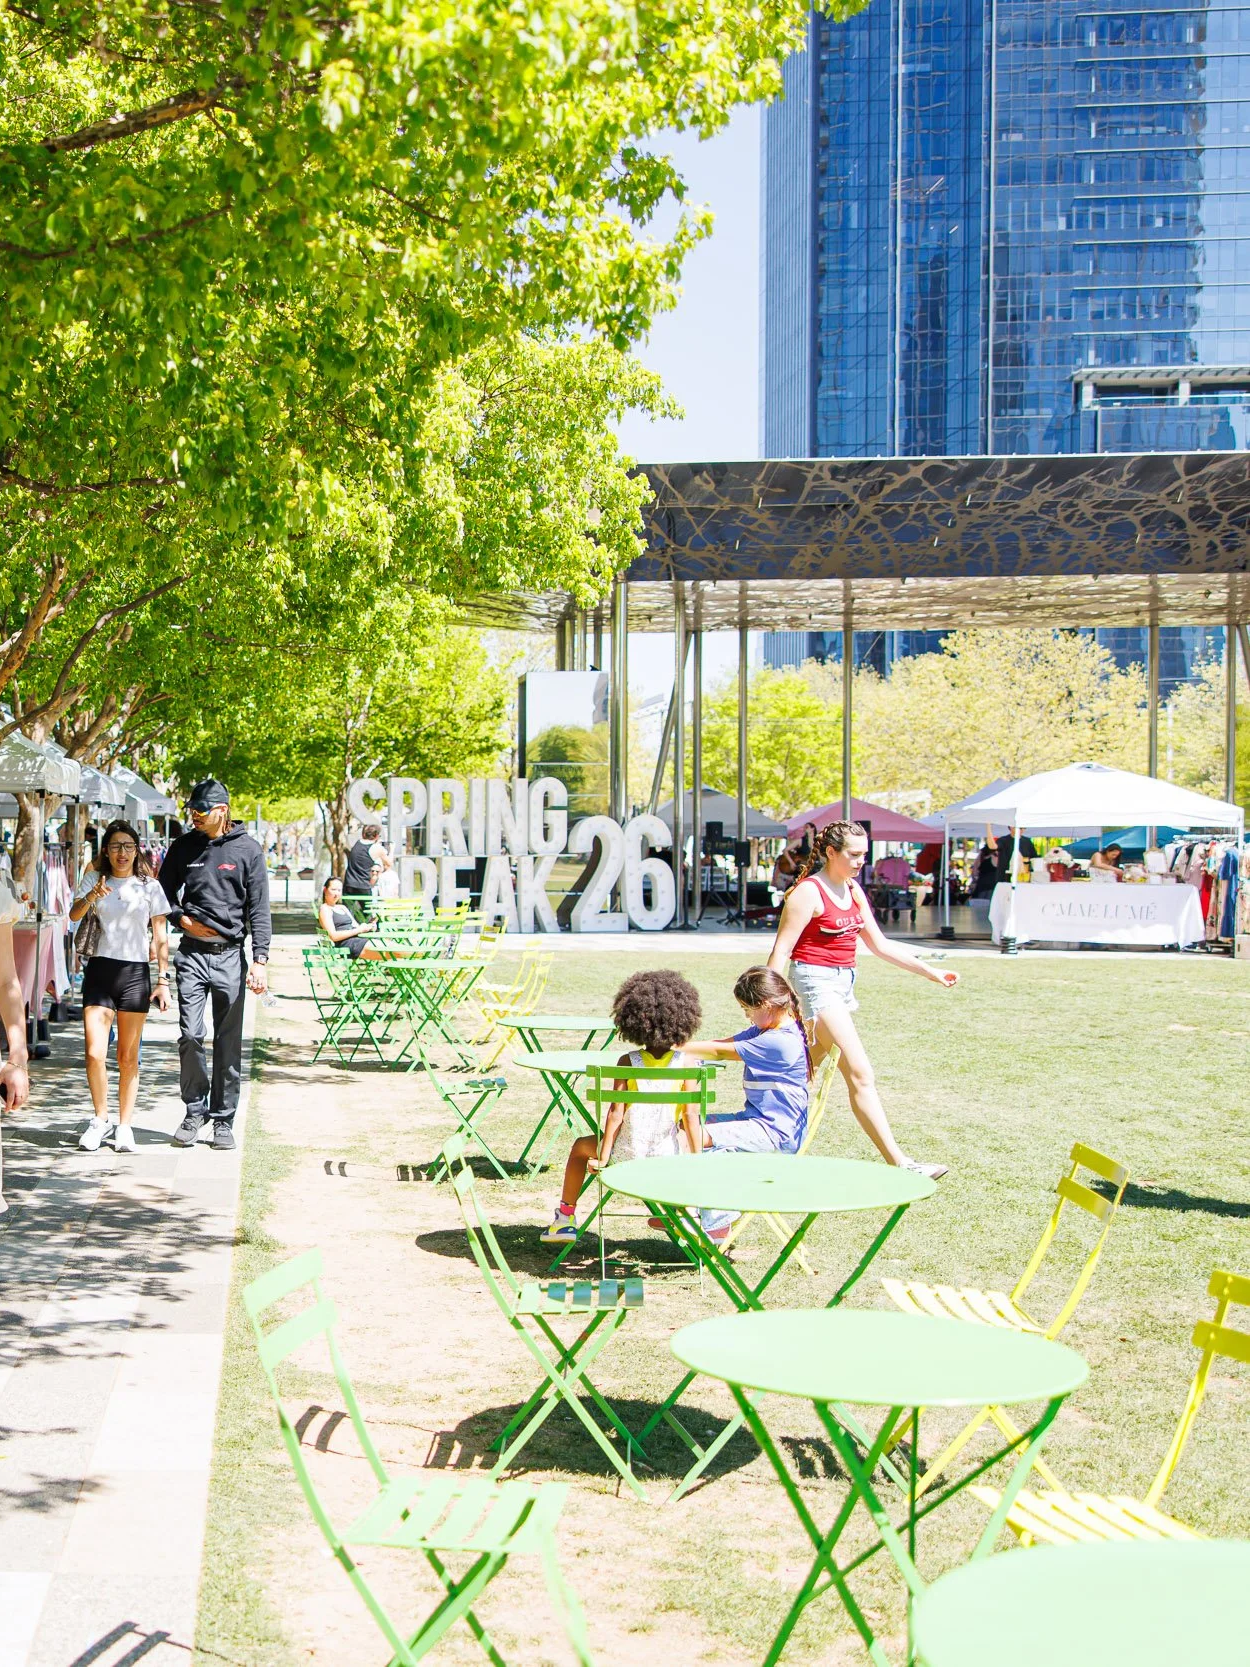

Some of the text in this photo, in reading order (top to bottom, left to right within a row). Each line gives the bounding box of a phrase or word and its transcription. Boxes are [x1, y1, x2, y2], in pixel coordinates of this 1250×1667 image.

[347, 776, 569, 856] SPRING
[396, 855, 562, 933] REAK
[562, 813, 677, 932] 26
